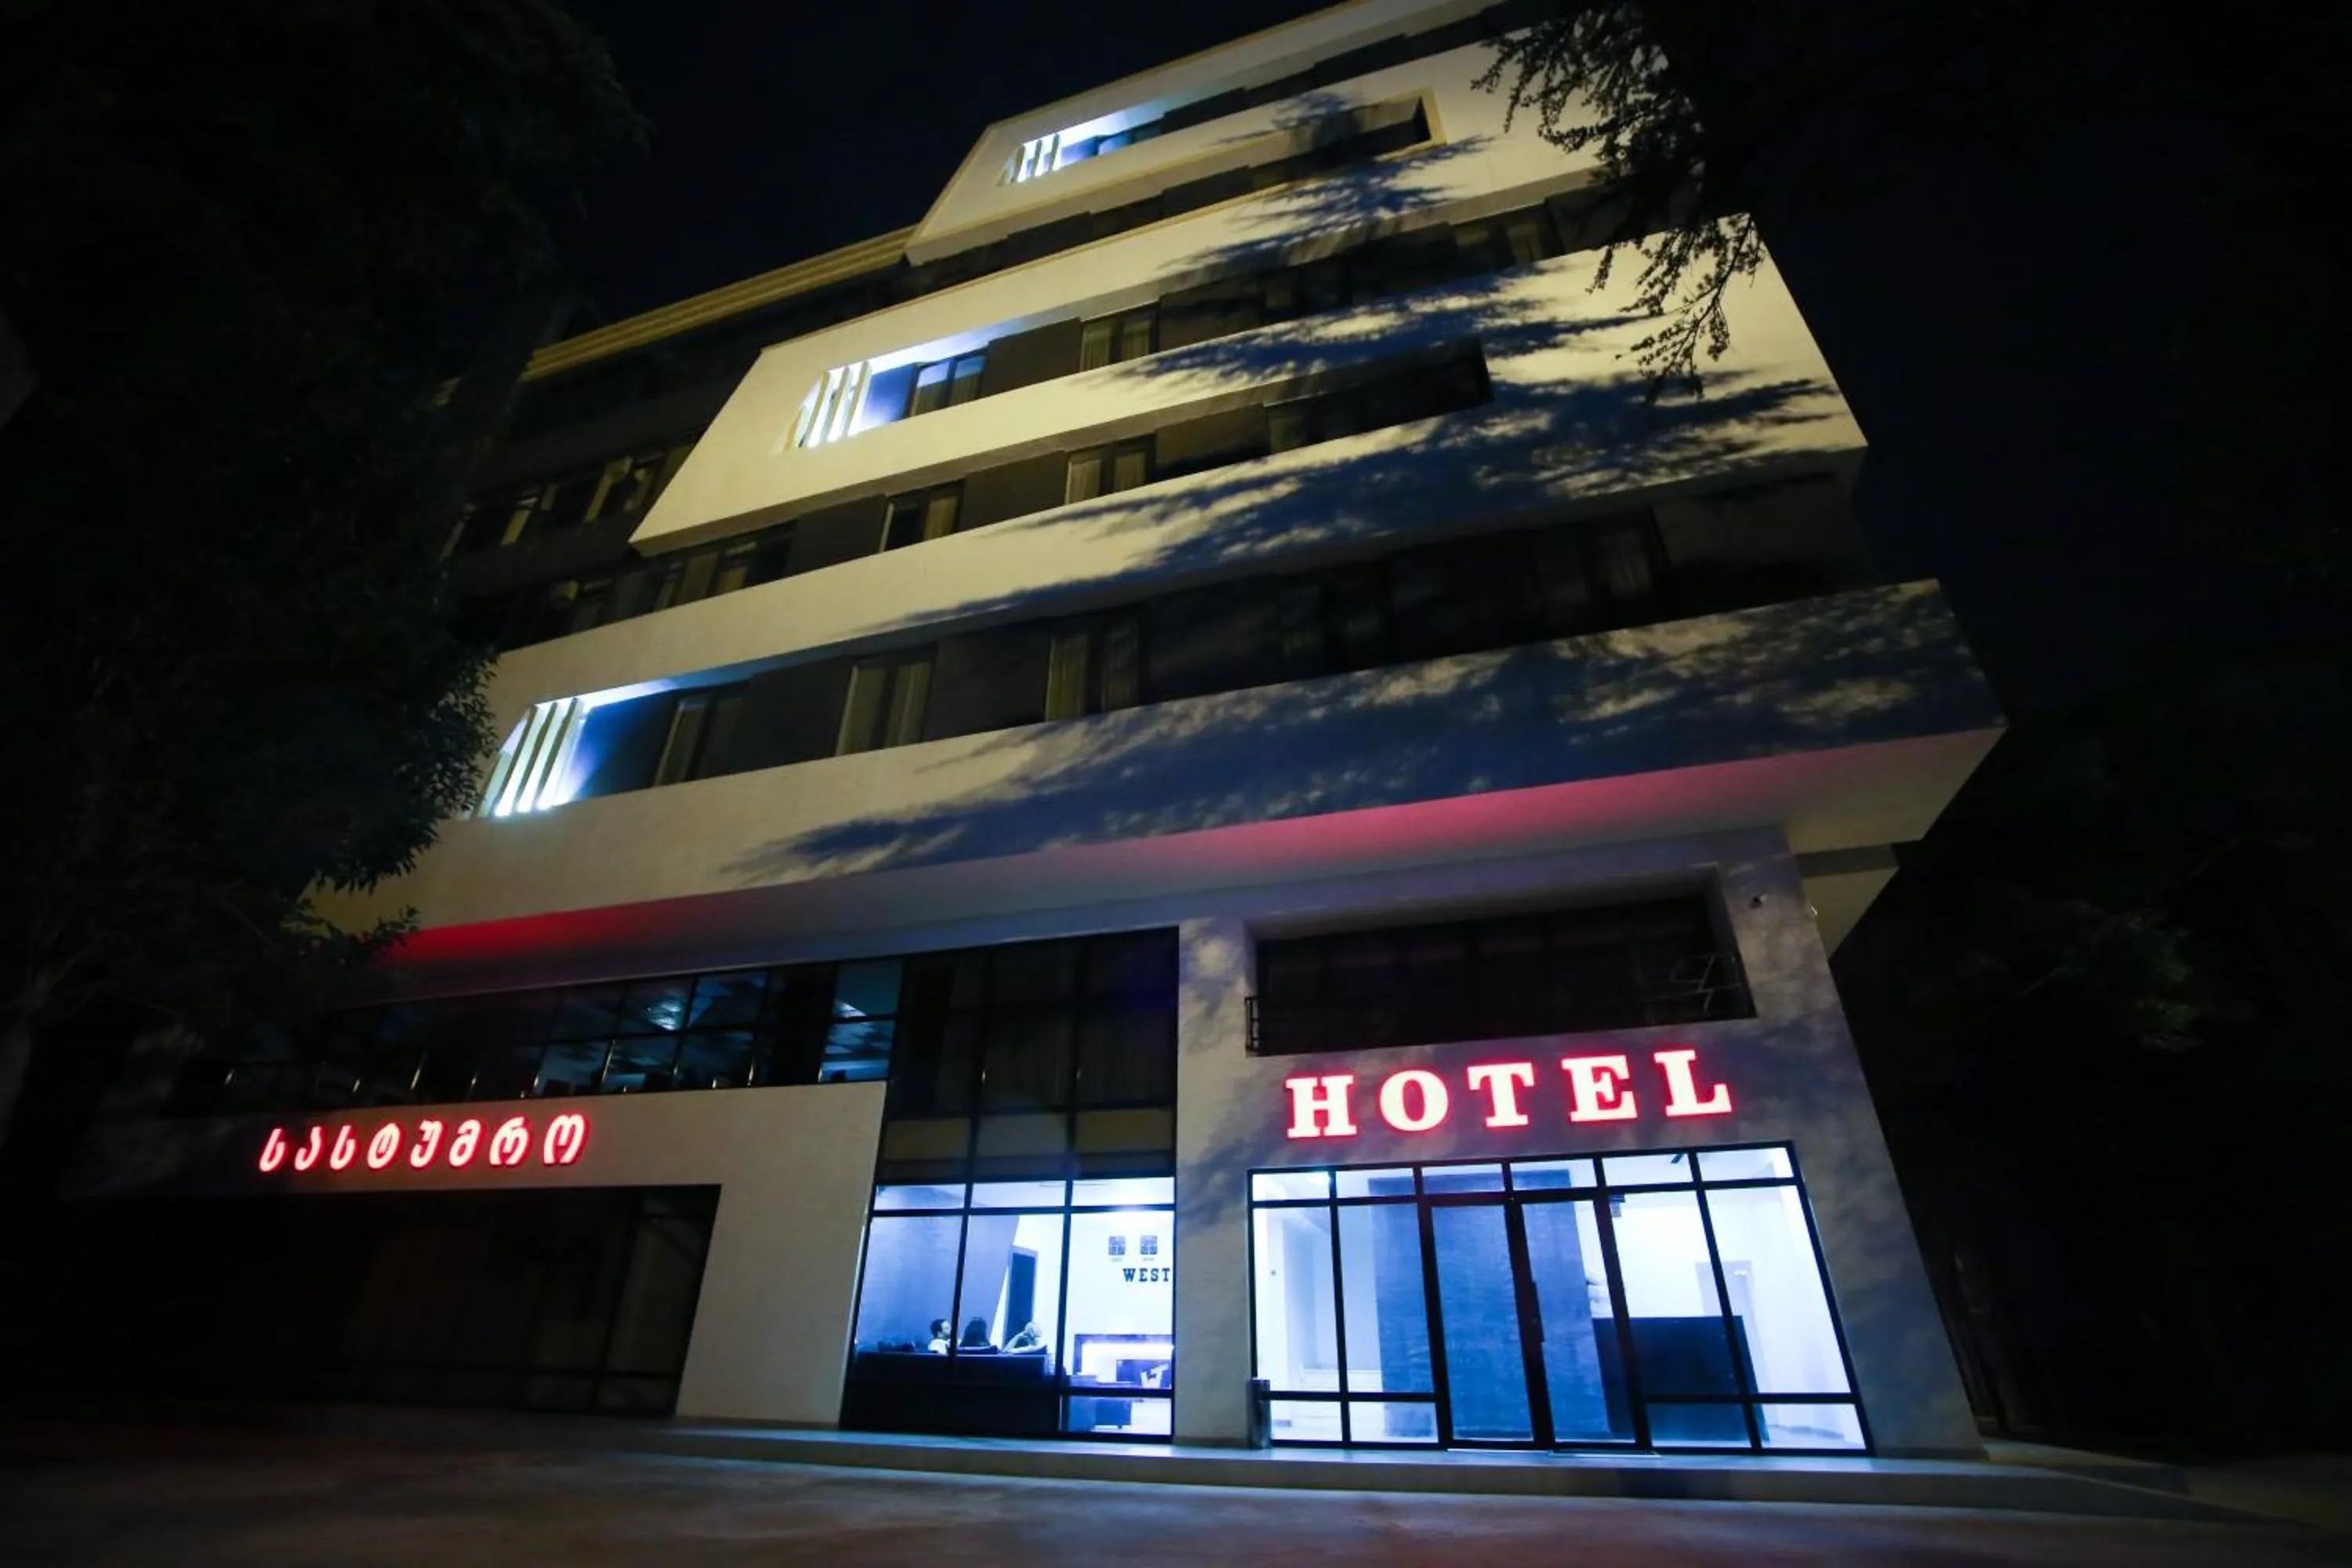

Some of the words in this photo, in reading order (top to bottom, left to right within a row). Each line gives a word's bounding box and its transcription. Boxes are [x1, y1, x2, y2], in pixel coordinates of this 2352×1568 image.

[1284, 1049, 1733, 1139] HOTEL
[257, 1112, 588, 1173] სასტუმრო
[1123, 1268, 1171, 1283] WEST
